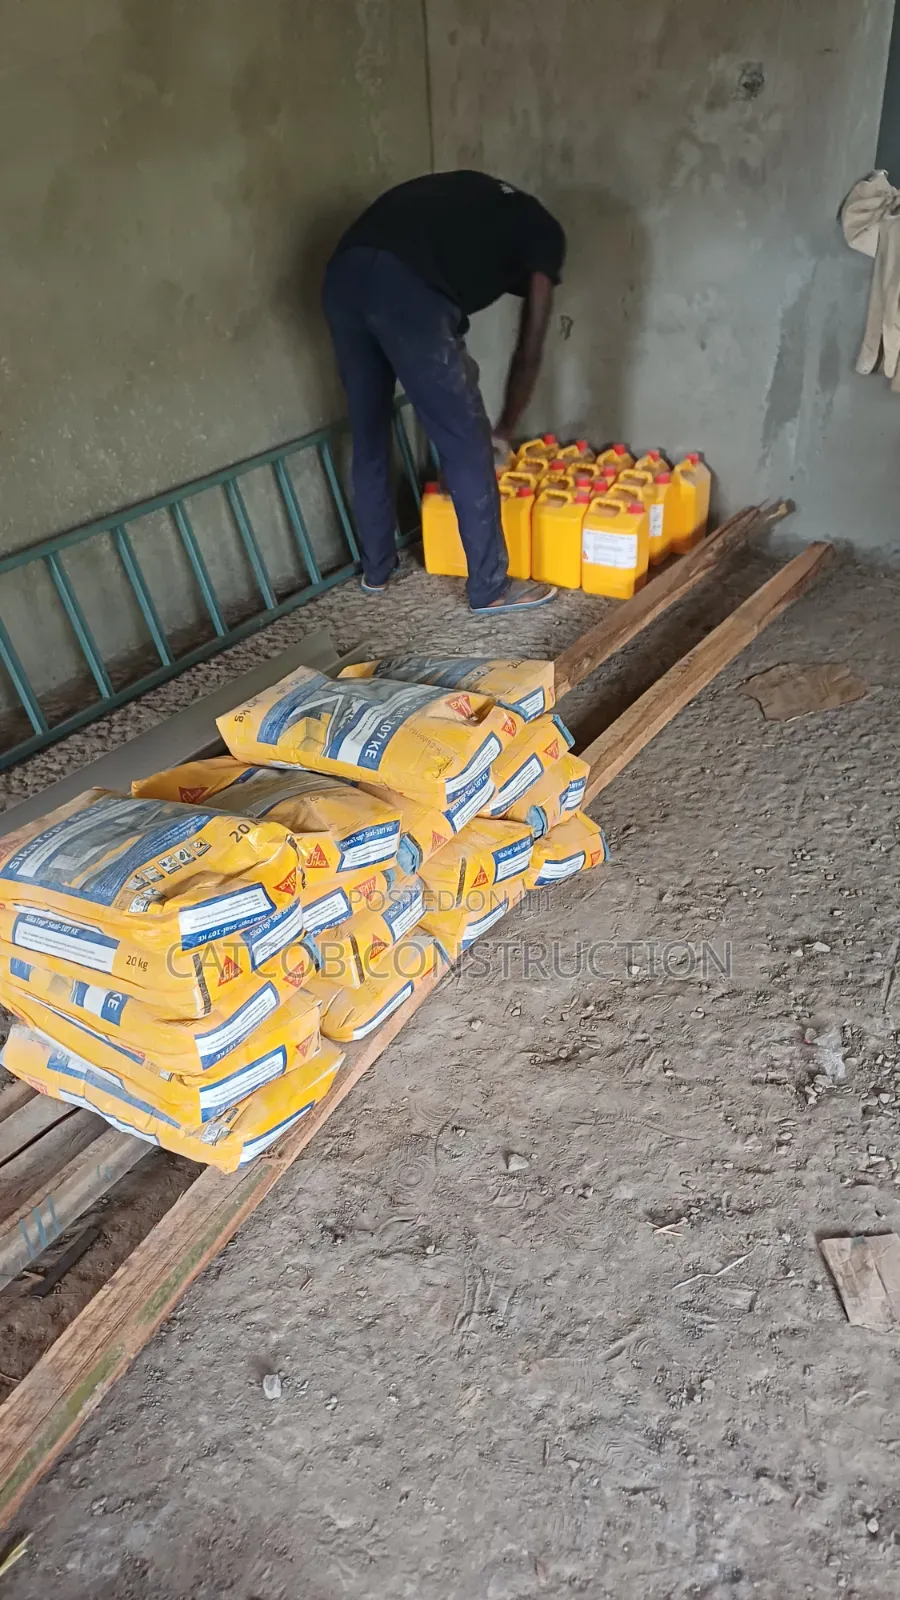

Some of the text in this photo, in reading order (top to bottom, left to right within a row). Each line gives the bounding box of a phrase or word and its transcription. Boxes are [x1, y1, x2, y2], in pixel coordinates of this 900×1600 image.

[365, 740, 380, 759] KE
[229, 822, 251, 843] 20
[305, 849, 327, 867] Sika
[48, 921, 71, 934] Seal-107
[70, 928, 80, 936] KE
[207, 924, 237, 939] Seal-107
[197, 934, 207, 943] KE
[125, 955, 149, 972] 20 kg
[219, 962, 241, 984] Sika
